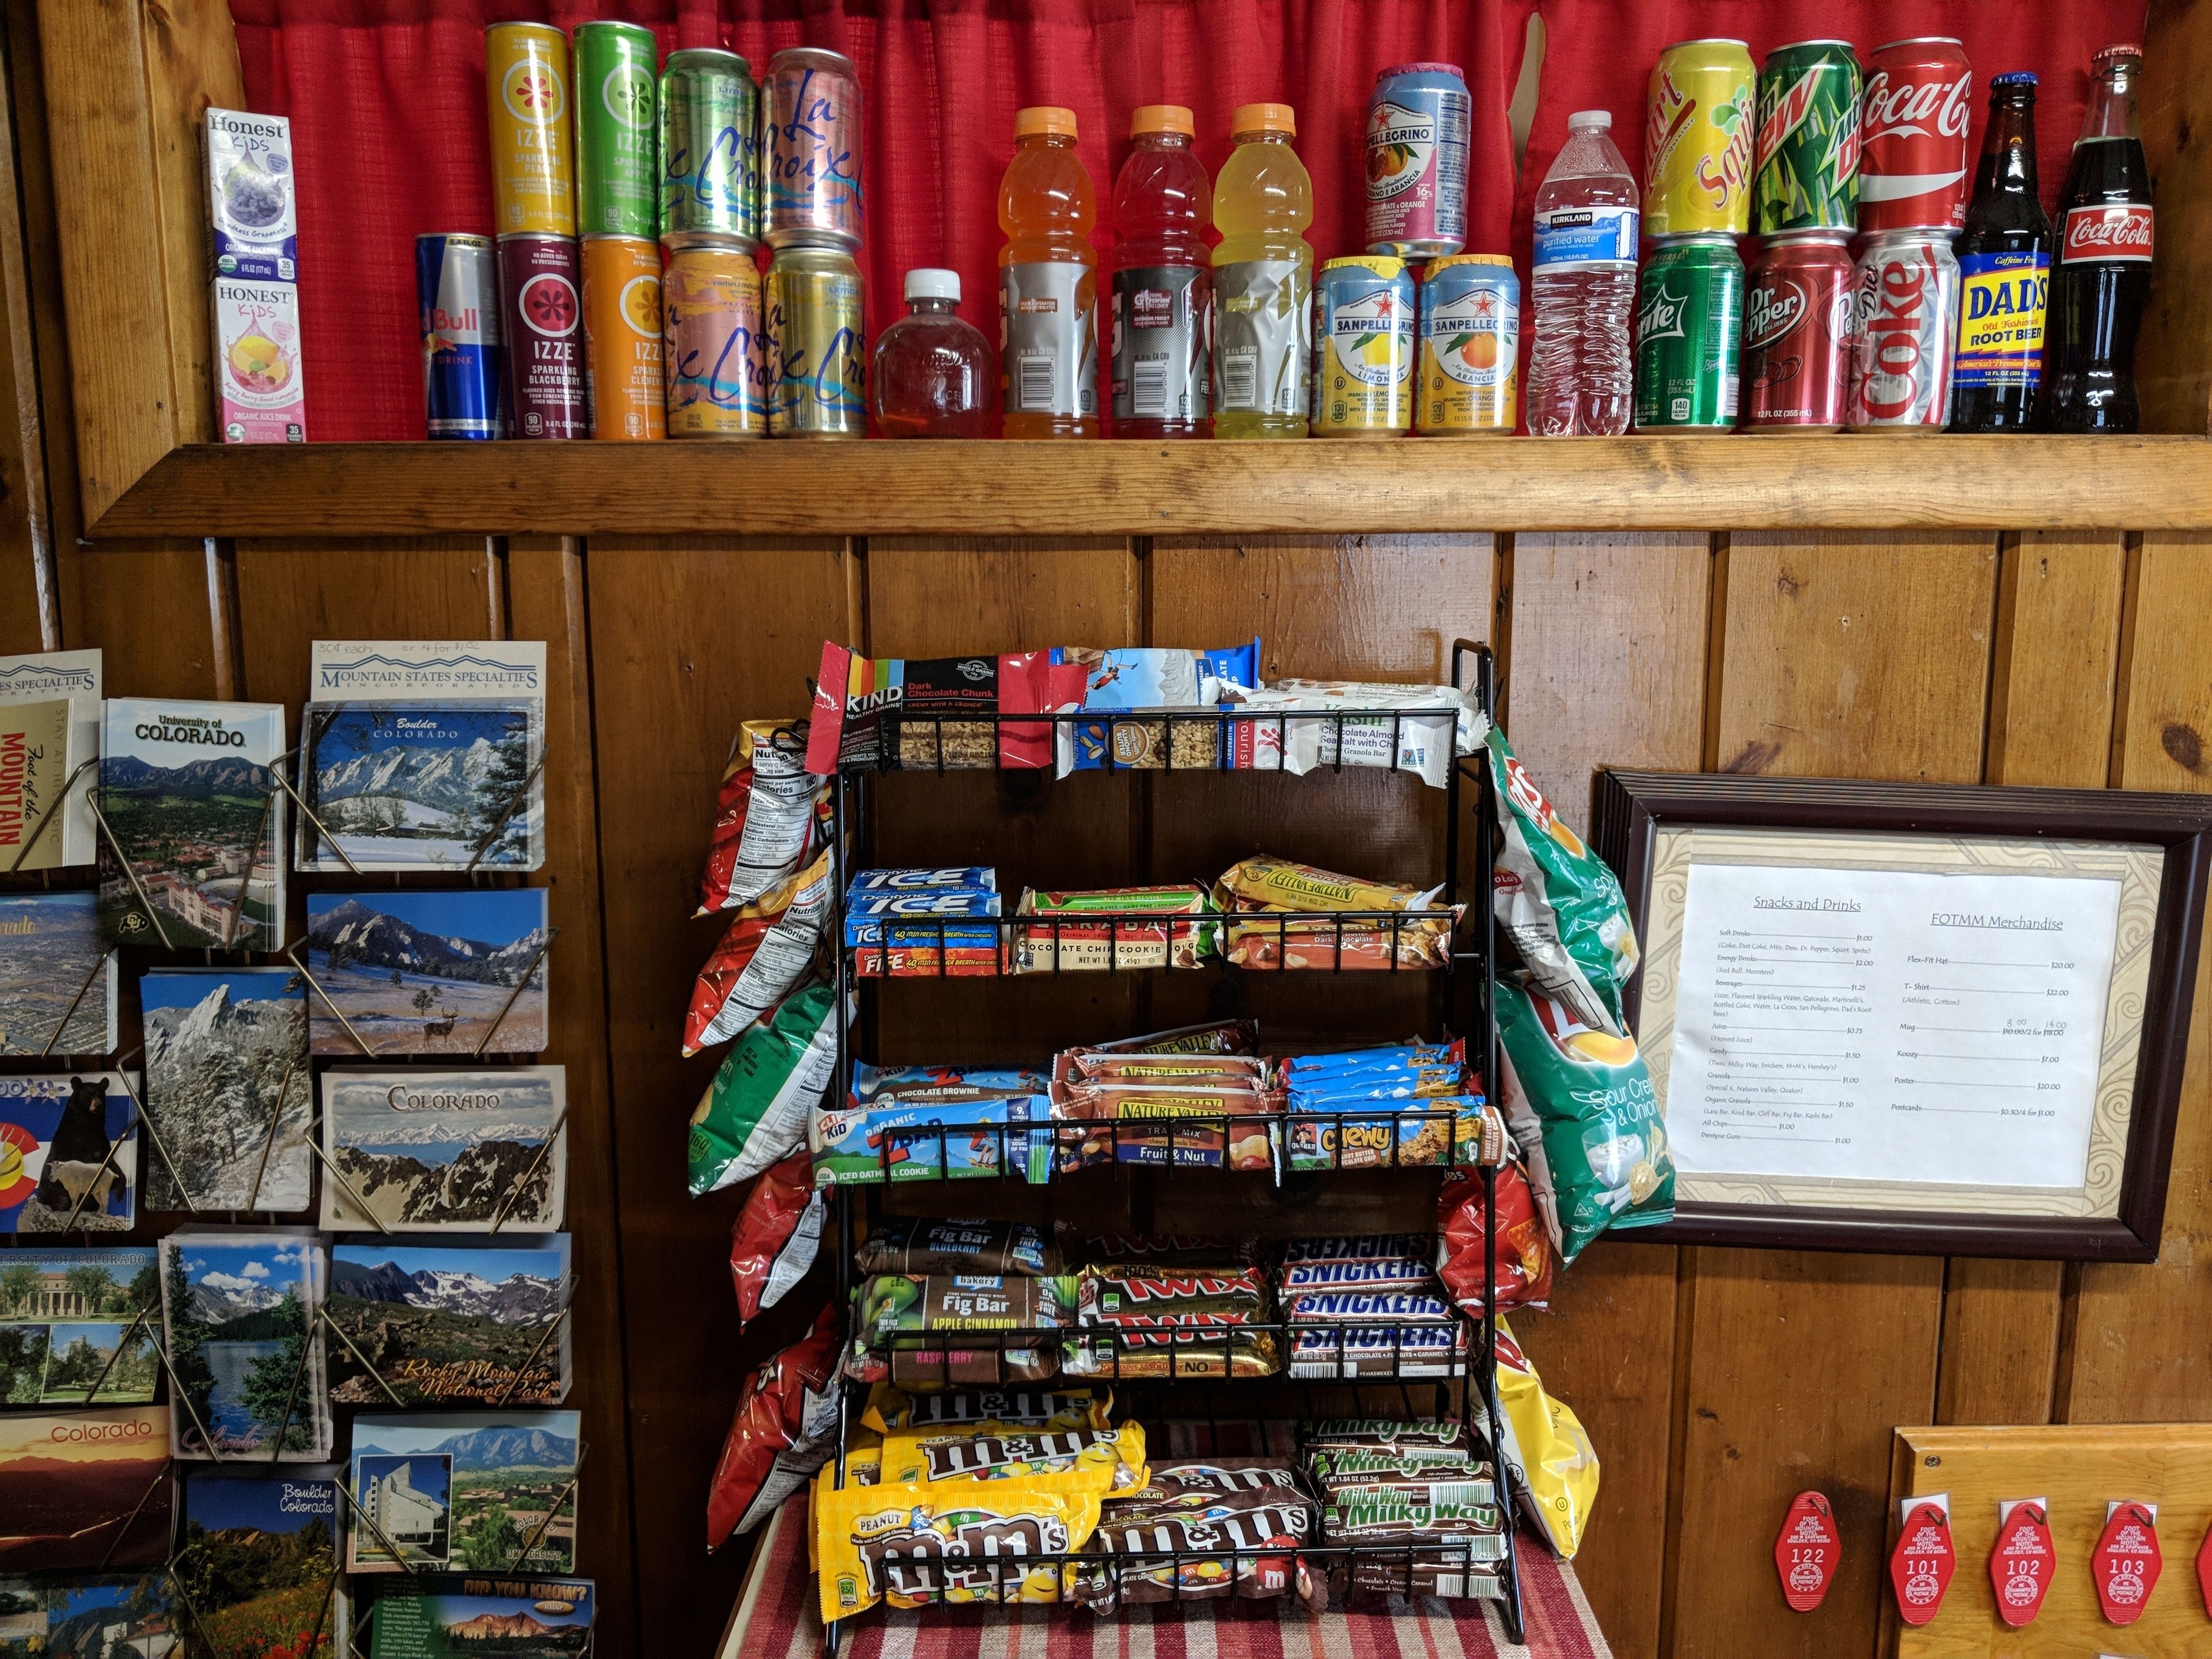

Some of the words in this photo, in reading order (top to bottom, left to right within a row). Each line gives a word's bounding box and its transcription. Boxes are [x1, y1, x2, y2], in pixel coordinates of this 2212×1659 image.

[783, 69, 836, 142] La
[1863, 70, 1972, 139] Coca-C
[210, 115, 286, 138] Honest
[1368, 128, 1429, 146] PELLEGRINO
[1391, 170, 1421, 193] ARANCIA
[1552, 214, 1592, 224] KIRKLAND
[2070, 215, 2151, 248] Coca-Cola
[1543, 235, 1572, 249] purified
[1574, 235, 1599, 244] water
[1995, 256, 2022, 266] Caffeine
[219, 287, 290, 304] HONEST
[1750, 287, 1775, 313] Dr
[1858, 264, 1879, 320] Diet
[1968, 276, 2047, 320] DAD'S
[434, 309, 477, 331] Bull
[1983, 321, 1998, 331] Old
[2001, 317, 2039, 329] Fashioned
[1859, 261, 1925, 419] Coke
[1971, 330, 2013, 346] ROOT
[2016, 327, 2041, 340] BEER
[535, 341, 573, 361] IZZE
[439, 357, 472, 365] DRINK
[529, 376, 580, 385] BLACKBERRY
[1456, 373, 1495, 382] ARANCIA
[1674, 401, 1687, 410] 140
[14, 674, 94, 690] SPECIALTIES
[320, 671, 402, 688] MOUNTAIN
[406, 672, 451, 682] STATES
[455, 672, 537, 688] SPECIALTIES
[908, 682, 931, 690] Dark
[846, 685, 903, 713] KIND
[908, 689, 960, 698] Chocolate
[961, 689, 994, 698] Chunk
[846, 709, 873, 720] HEALTHY
[875, 702, 902, 712] GRAINS
[159, 715, 210, 728] University
[212, 719, 222, 728] of
[397, 718, 438, 729] Boulder
[135, 724, 245, 747] COLORADO
[374, 730, 458, 738] COLORADO
[1116, 732, 1126, 756] BUTTER
[1121, 729, 1131, 757] ALMOND
[1358, 739, 1377, 747] with
[1, 732, 25, 846] MOUNTAIN
[745, 827, 764, 835] Sodium
[865, 868, 973, 888] ICE
[1308, 885, 1351, 900] NATURE
[867, 894, 978, 914] ICE
[1753, 896, 1793, 908] Snacks
[1797, 898, 1819, 910] and
[1824, 899, 1861, 912] Drinks
[1930, 913, 1984, 927] FOTMM
[1988, 915, 2063, 930] Merchandise
[1717, 955, 1737, 963] Energy
[1907, 956, 1934, 964] Flex-Fit
[1899, 1023, 1915, 1032] Mug
[1897, 1050, 1918, 1059] Koozy
[1894, 1077, 1915, 1085] Poster
[387, 1085, 501, 1112] COLORADO
[897, 1089, 941, 1098] CHOCOLATE
[1589, 1087, 1626, 1109] Sour
[1123, 1103, 1174, 1118] NATURE
[1627, 1099, 1657, 1123] Onion
[1891, 1103, 1922, 1112] Postcards
[865, 1112, 915, 1137] ORGANIC
[1182, 1129, 1201, 1138] MIX
[1701, 1132, 1725, 1140] Dentyne
[1140, 1147, 1168, 1158] Fruit
[1184, 1149, 1206, 1161] Nut
[1291, 1142, 1316, 1150] QUAKER
[839, 1172, 858, 1180] ICED
[859, 1169, 898, 1179] OATMEL
[899, 1168, 929, 1176] COOKIE
[930, 1243, 982, 1254] BLUEBERRY
[77, 1253, 146, 1265] COLORADO
[1290, 1260, 1435, 1284] SNICKERS
[960, 1276, 995, 1286] bakery
[942, 1296, 973, 1316] Fig
[976, 1297, 1010, 1312] Bar
[1296, 1295, 1449, 1314] SNICKERS
[932, 1318, 963, 1330] APPLE
[965, 1319, 1017, 1330] CINNAMON
[916, 1353, 973, 1364] RASPERRY
[404, 1357, 459, 1380] Rocky
[1184, 1362, 1209, 1373] NO
[419, 1378, 505, 1397] National
[51, 1419, 152, 1443] Colorado
[282, 1483, 333, 1499] Boulder
[280, 1498, 334, 1514] Colorado
[860, 1514, 902, 1531] PEANUT
[1347, 1504, 1431, 1528] Milky
[1434, 1503, 1497, 1528] Way
[506, 1549, 562, 1560] UNVERSITY
[1791, 1548, 1824, 1563] 122
[1907, 1559, 1938, 1575] 101
[2006, 1560, 2040, 1575] 102
[2109, 1559, 2144, 1574] 103
[495, 1581, 526, 1597] YOU
[531, 1583, 587, 1601] KNOW?
